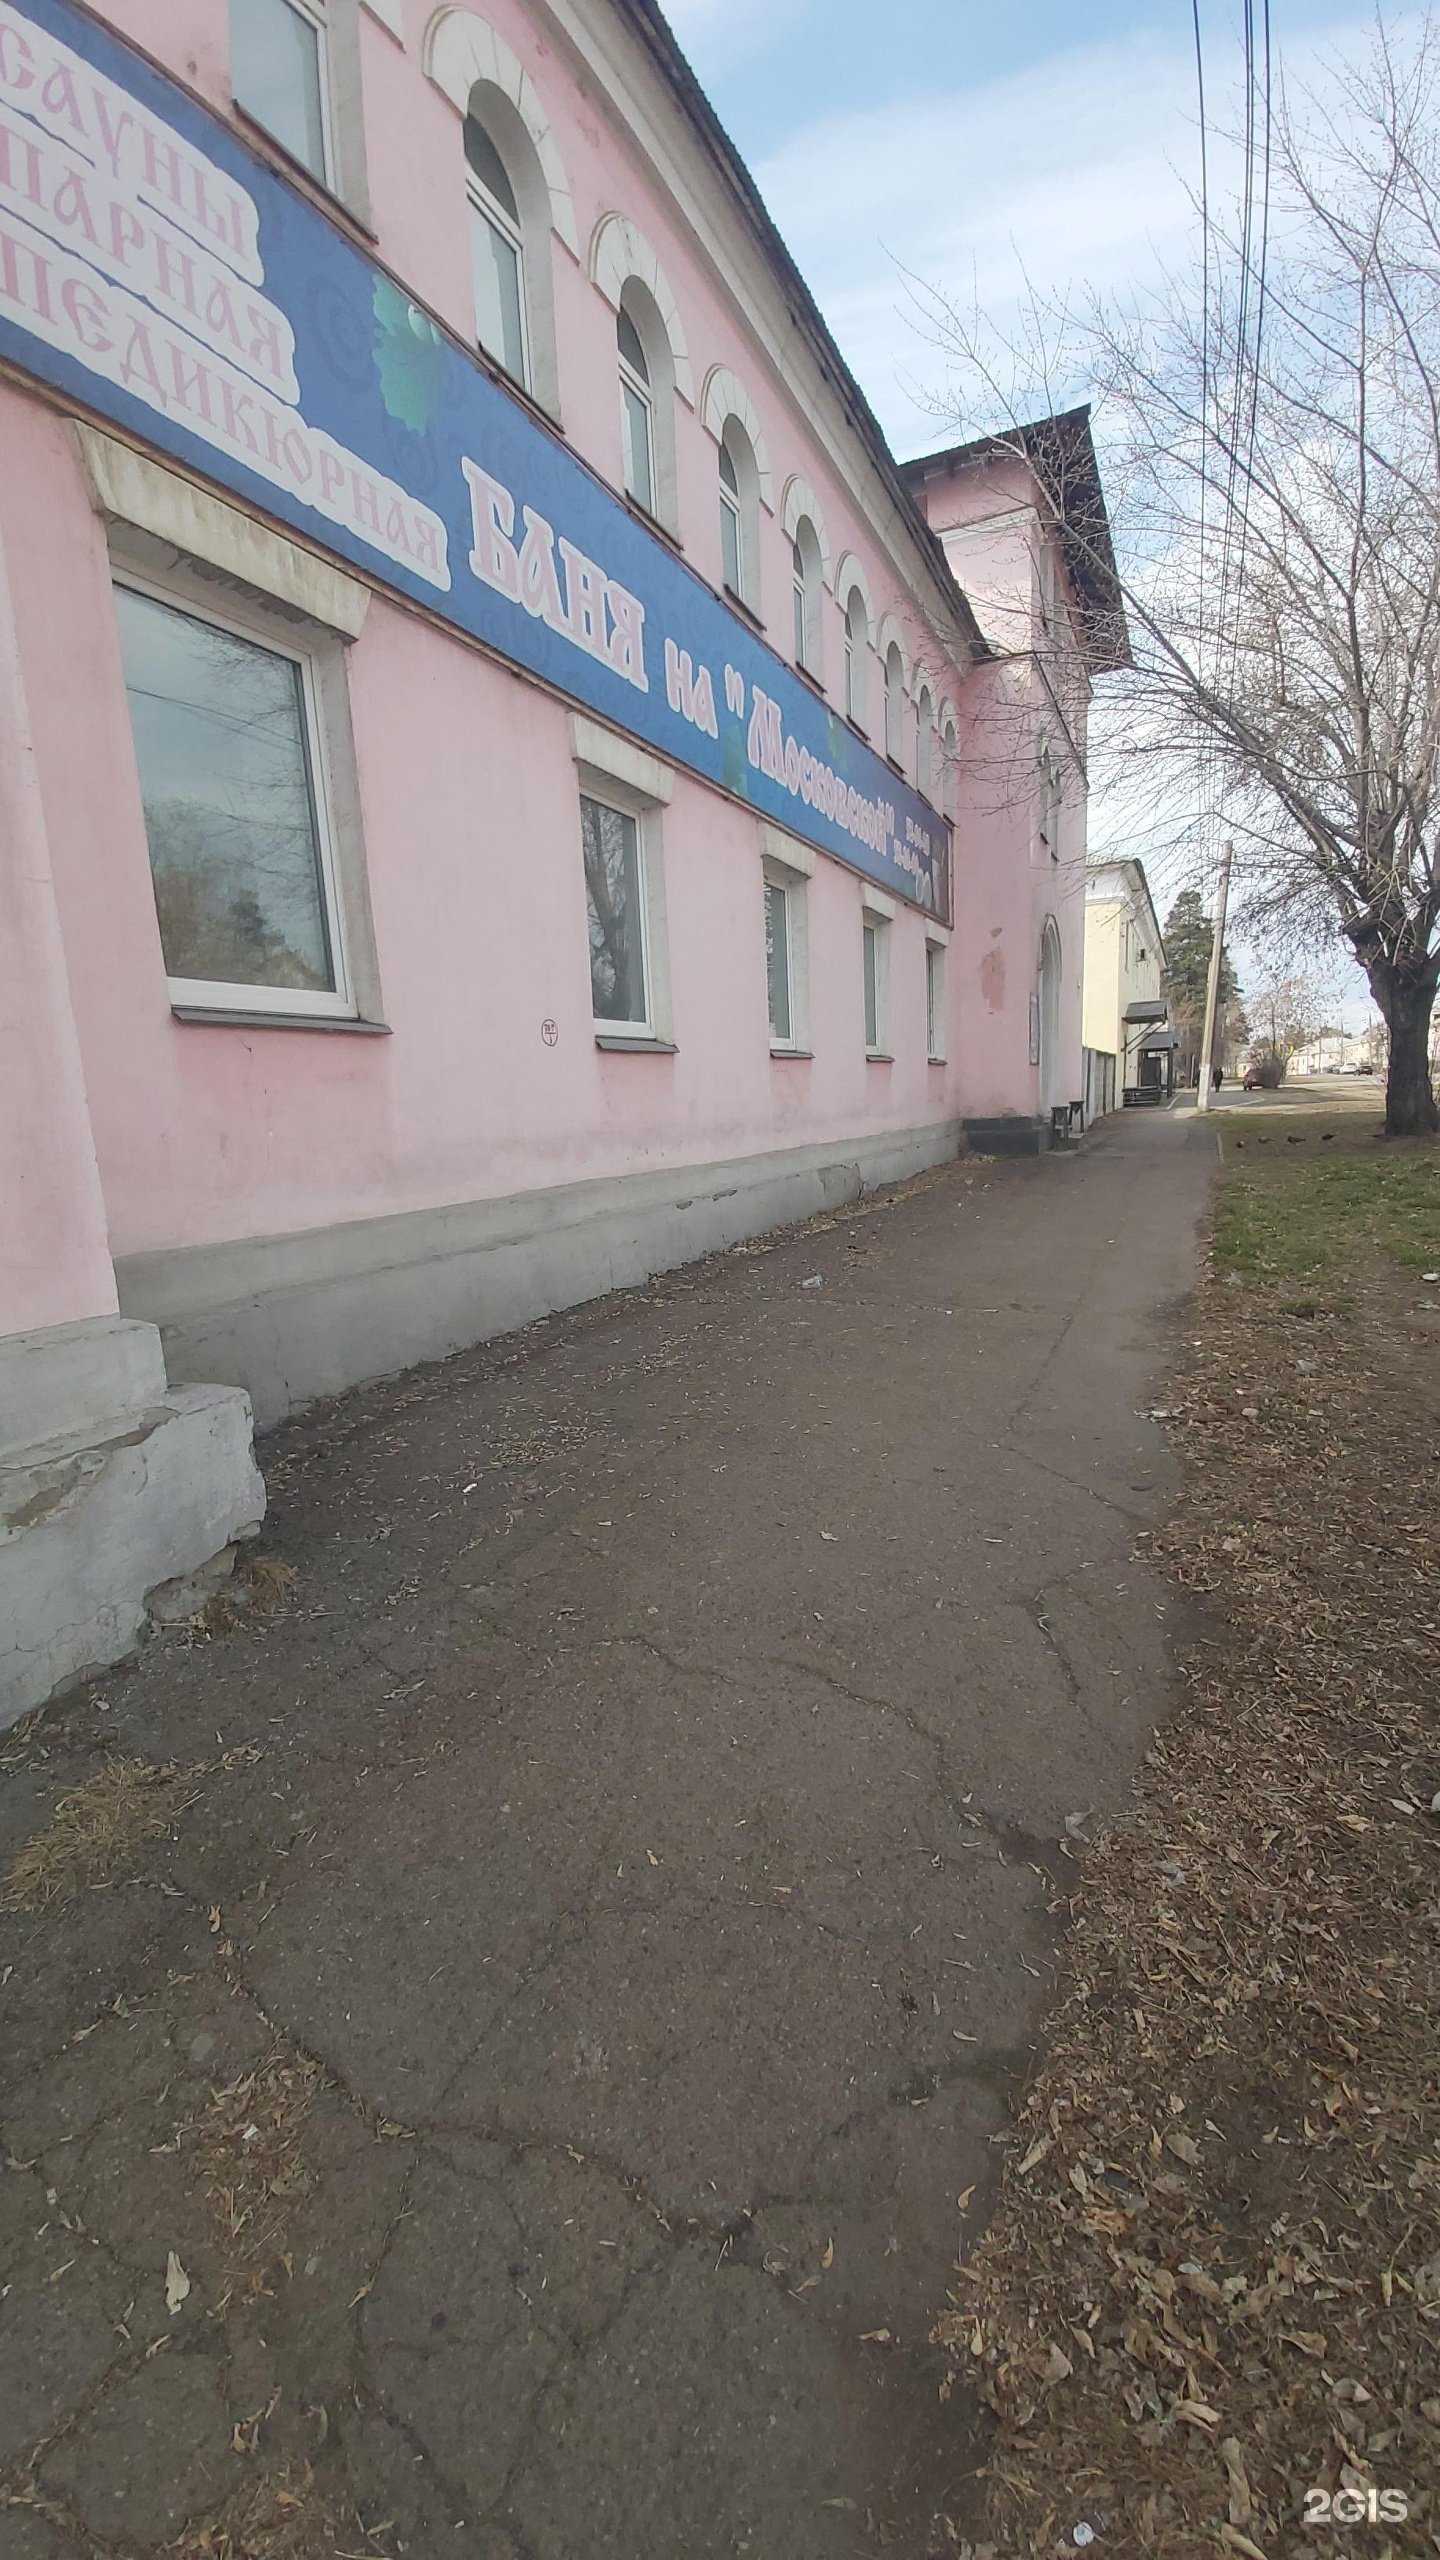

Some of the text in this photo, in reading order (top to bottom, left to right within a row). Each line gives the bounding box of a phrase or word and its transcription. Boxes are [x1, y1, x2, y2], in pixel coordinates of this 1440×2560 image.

[0, 22, 251, 263] САУНЫ
[0, 122, 288, 382] ПАРНАЯ
[462, 456, 649, 693] БАНЯ
